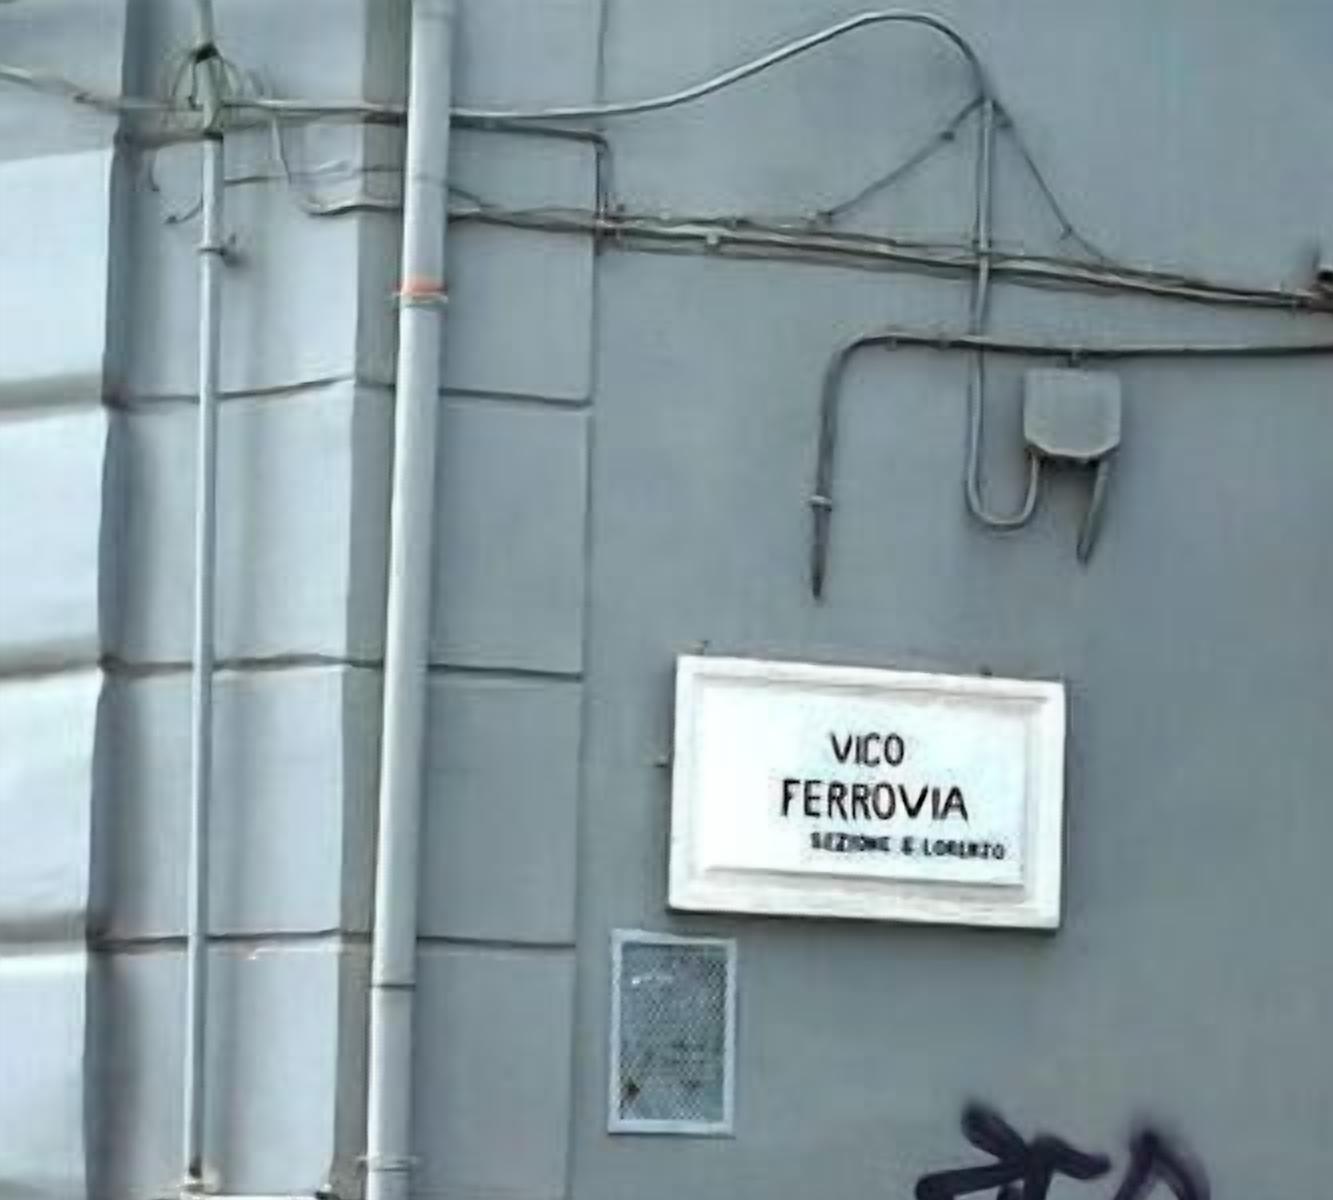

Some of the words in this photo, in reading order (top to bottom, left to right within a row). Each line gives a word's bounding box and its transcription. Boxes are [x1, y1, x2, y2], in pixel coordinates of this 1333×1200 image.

[830, 732, 906, 767] VICO
[781, 778, 969, 822] FERROVIA
[811, 832, 890, 853] SEZIONE
